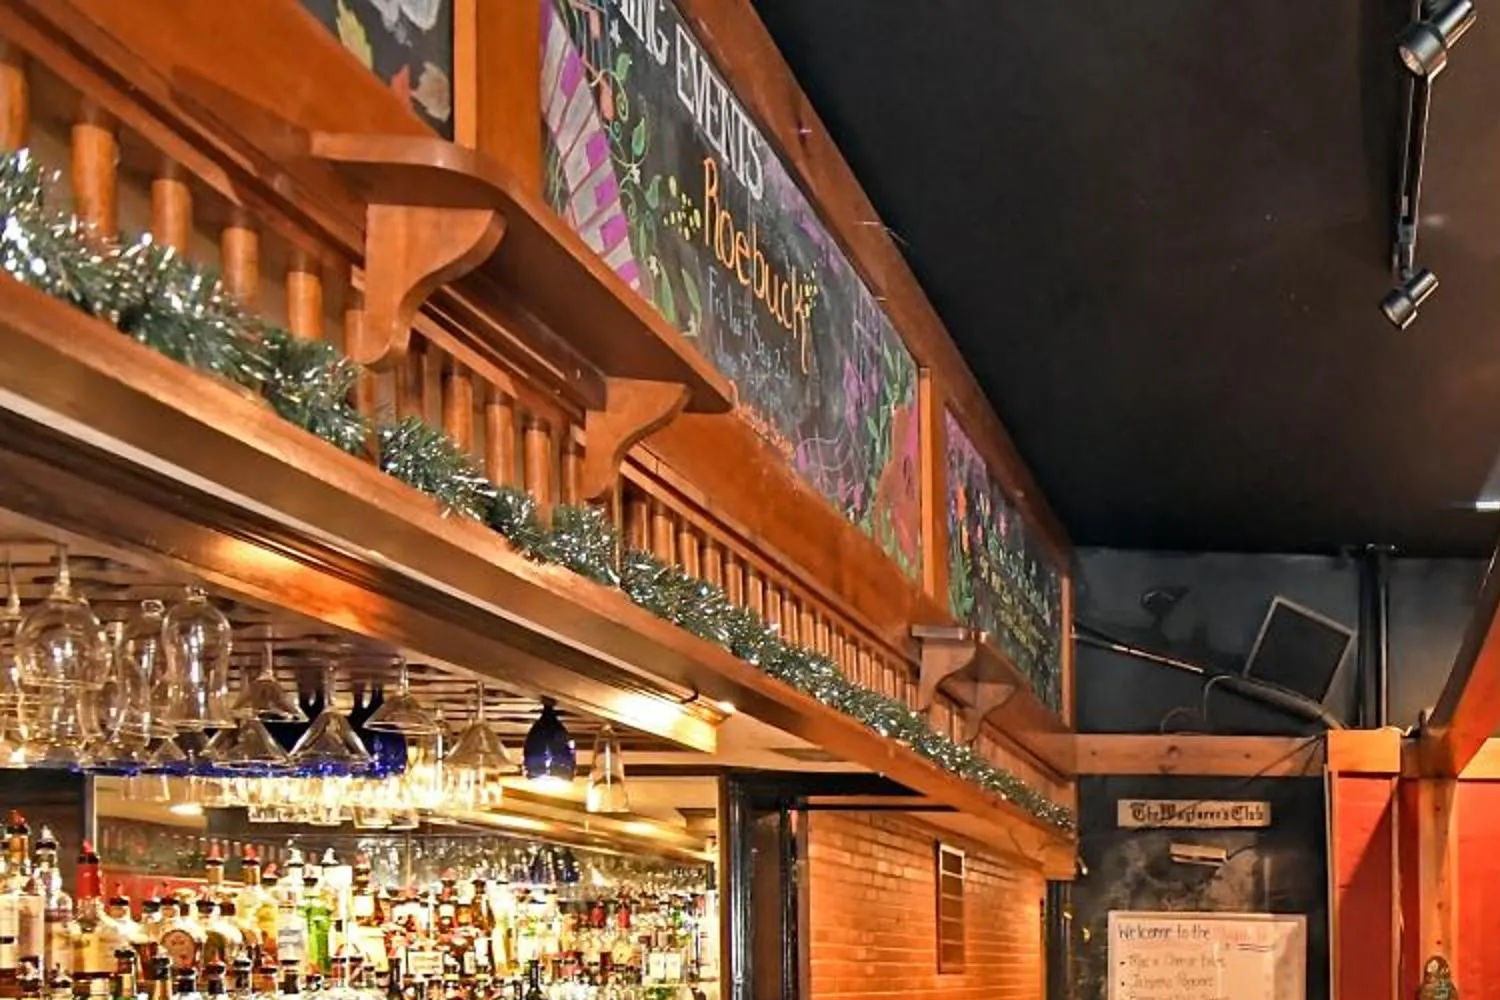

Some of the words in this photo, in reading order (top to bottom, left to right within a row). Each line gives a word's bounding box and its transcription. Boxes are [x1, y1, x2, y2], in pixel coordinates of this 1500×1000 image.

[676, 23, 763, 200] EVENTS
[704, 157, 808, 374] Roebuck
[1131, 803, 1158, 822] The
[1231, 804, 1263, 821] Club
[1118, 924, 1172, 940] Welcome
[1193, 922, 1210, 940] the
